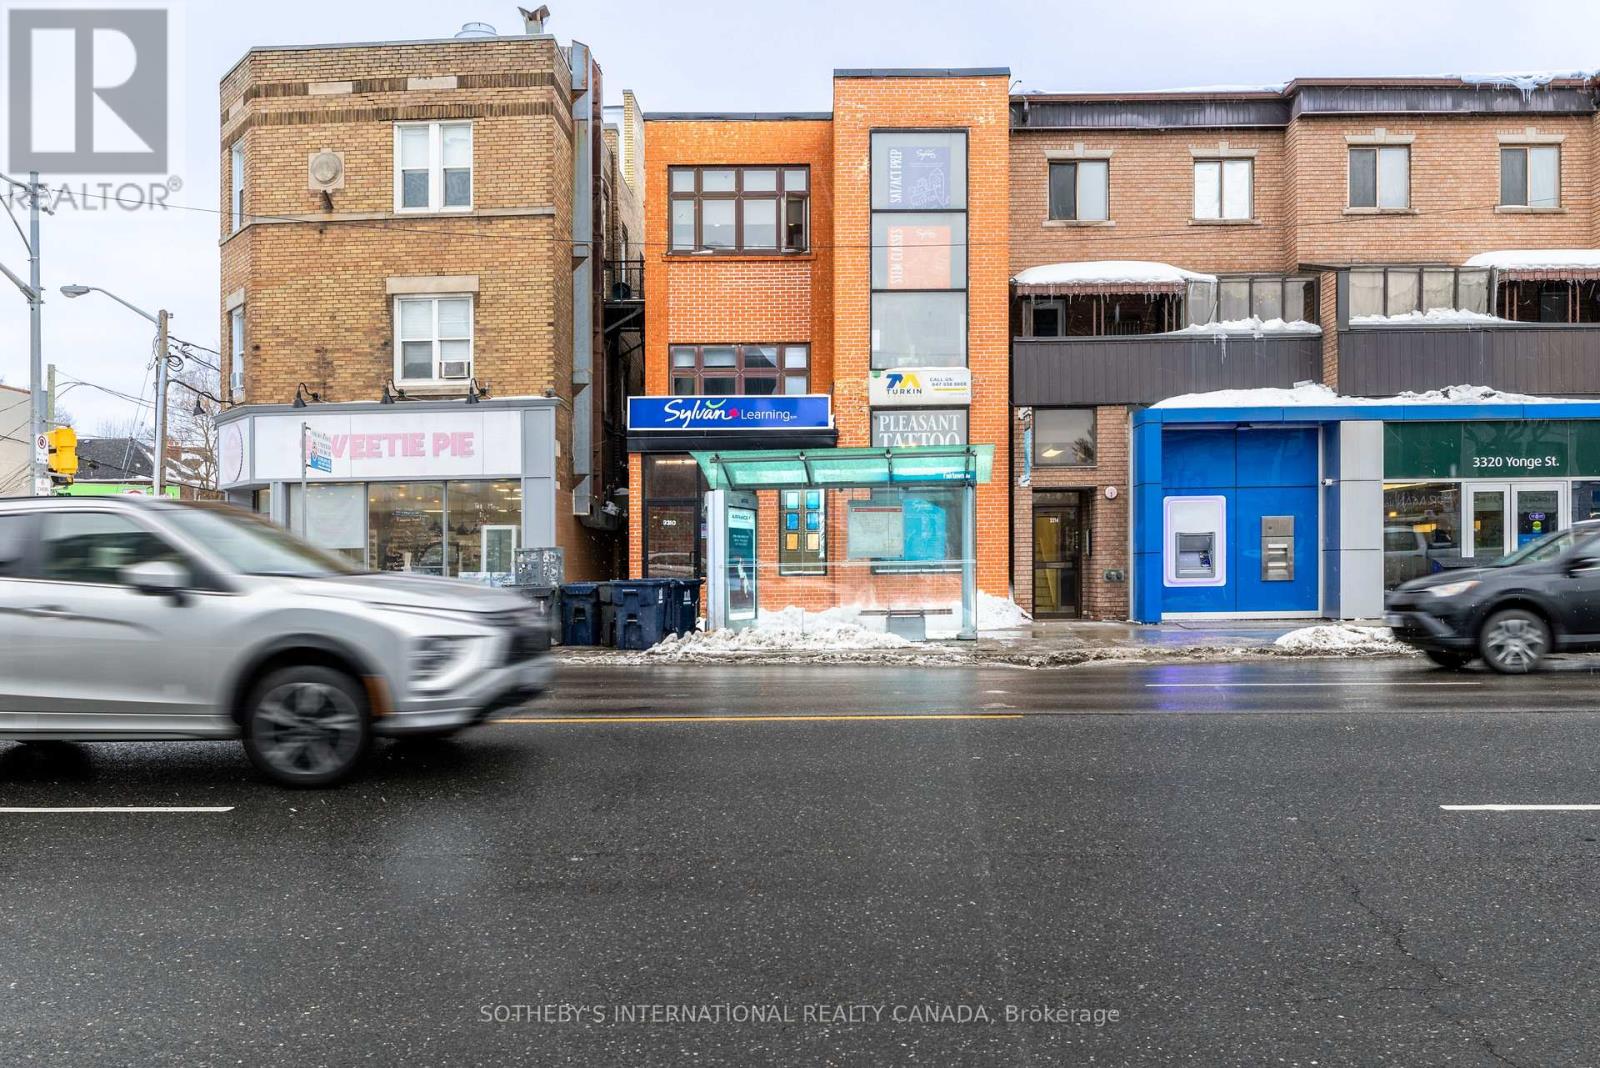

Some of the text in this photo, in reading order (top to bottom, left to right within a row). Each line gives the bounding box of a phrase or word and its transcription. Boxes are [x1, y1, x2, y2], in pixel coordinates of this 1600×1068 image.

[889, 149, 903, 168] PREP
[664, 399, 733, 429] Sylvan
[879, 415, 960, 432] PLEASANT
[432, 432, 475, 459] PIE
[1472, 456, 1560, 469] 3320 Yonge St.
